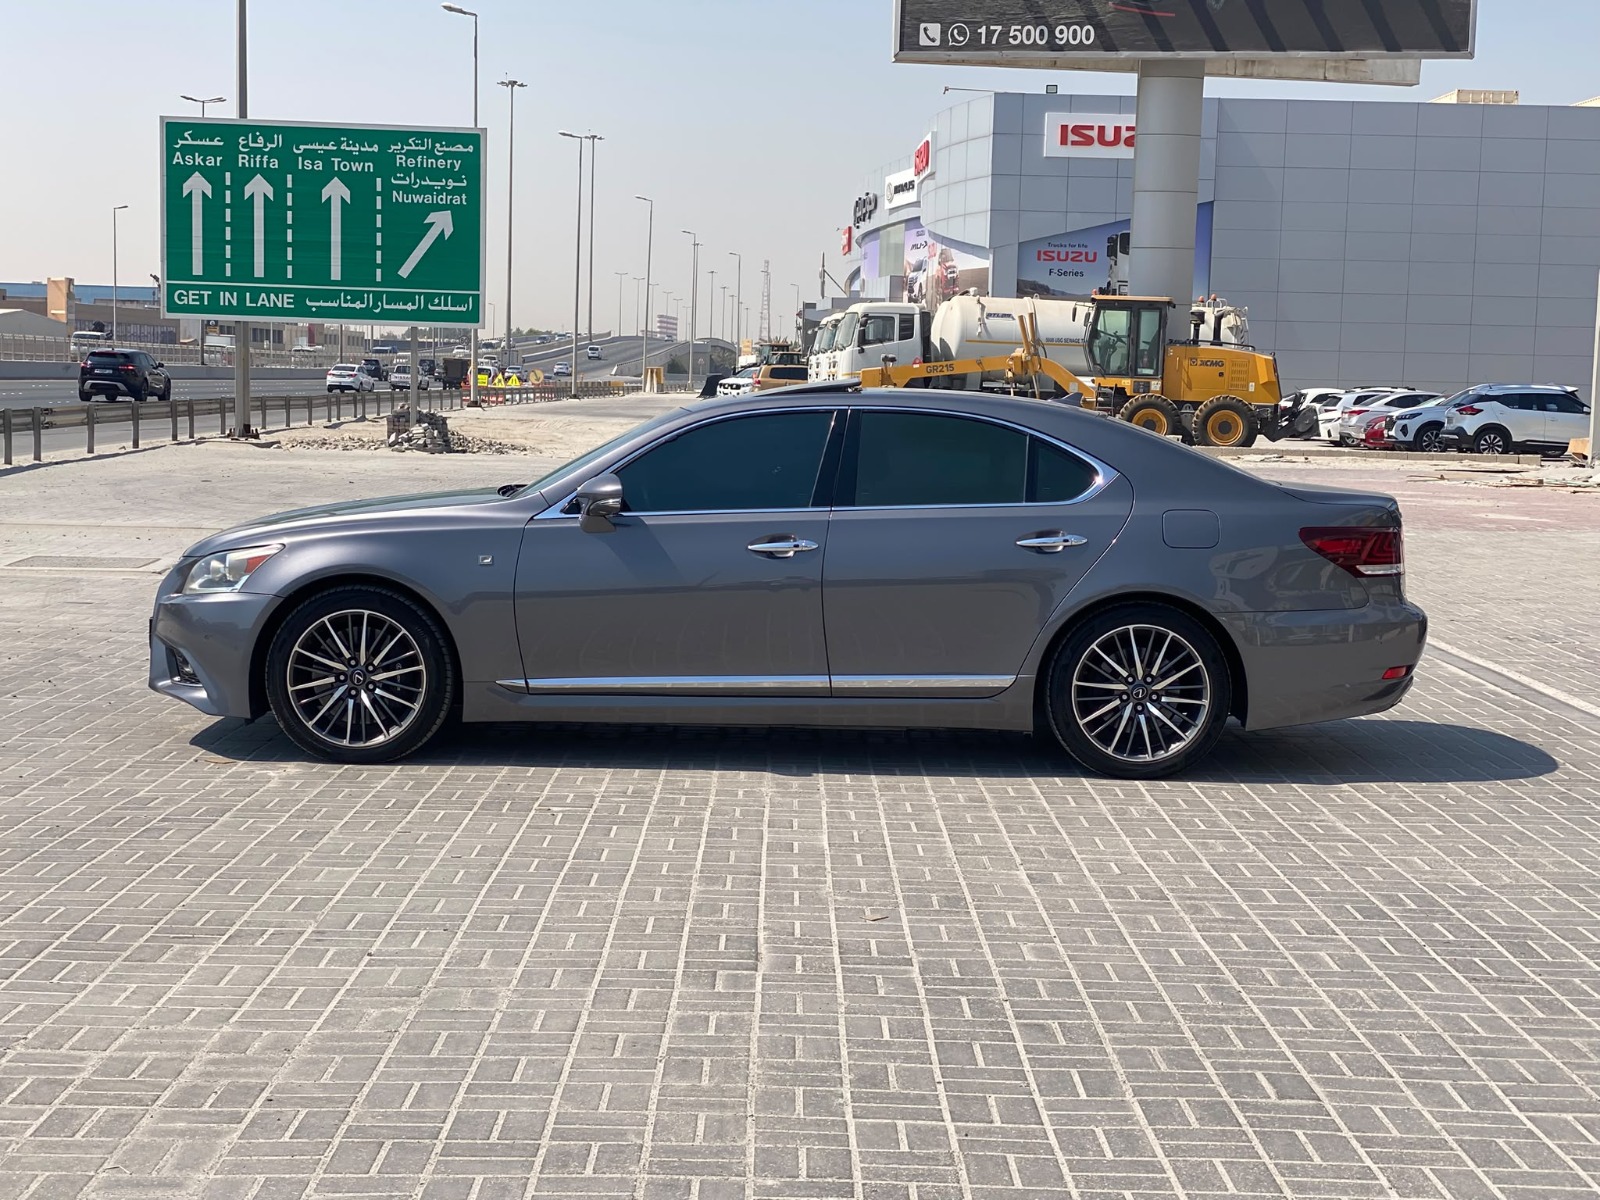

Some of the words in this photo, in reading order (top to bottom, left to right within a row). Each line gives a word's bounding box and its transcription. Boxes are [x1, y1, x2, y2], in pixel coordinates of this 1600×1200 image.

[977, 25, 1002, 45] 17
[1008, 25, 1048, 45] 500
[1055, 25, 1095, 45] 900
[173, 130, 224, 148] عسكر
[238, 131, 282, 151] الرفاع
[292, 140, 337, 153] عيسى
[340, 137, 379, 155] مدينة
[387, 137, 431, 153] التكرير
[434, 139, 474, 155] مصنع
[172, 152, 223, 167] Askar
[238, 154, 279, 169] Riffa
[298, 156, 323, 171] Isa
[331, 157, 374, 172] Town
[396, 155, 461, 171] Refinery
[391, 172, 467, 189] نويدرات
[392, 190, 467, 205] Nuwaidrat
[1037, 250, 1097, 263] ISUZU
[1049, 268, 1084, 278] F-Series
[174, 289, 212, 306] GET
[220, 291, 238, 306] IN
[246, 292, 295, 308] LANE
[428, 295, 473, 312] اسلك
[926, 363, 955, 374] GR215
[1199, 359, 1225, 368] XCMG
